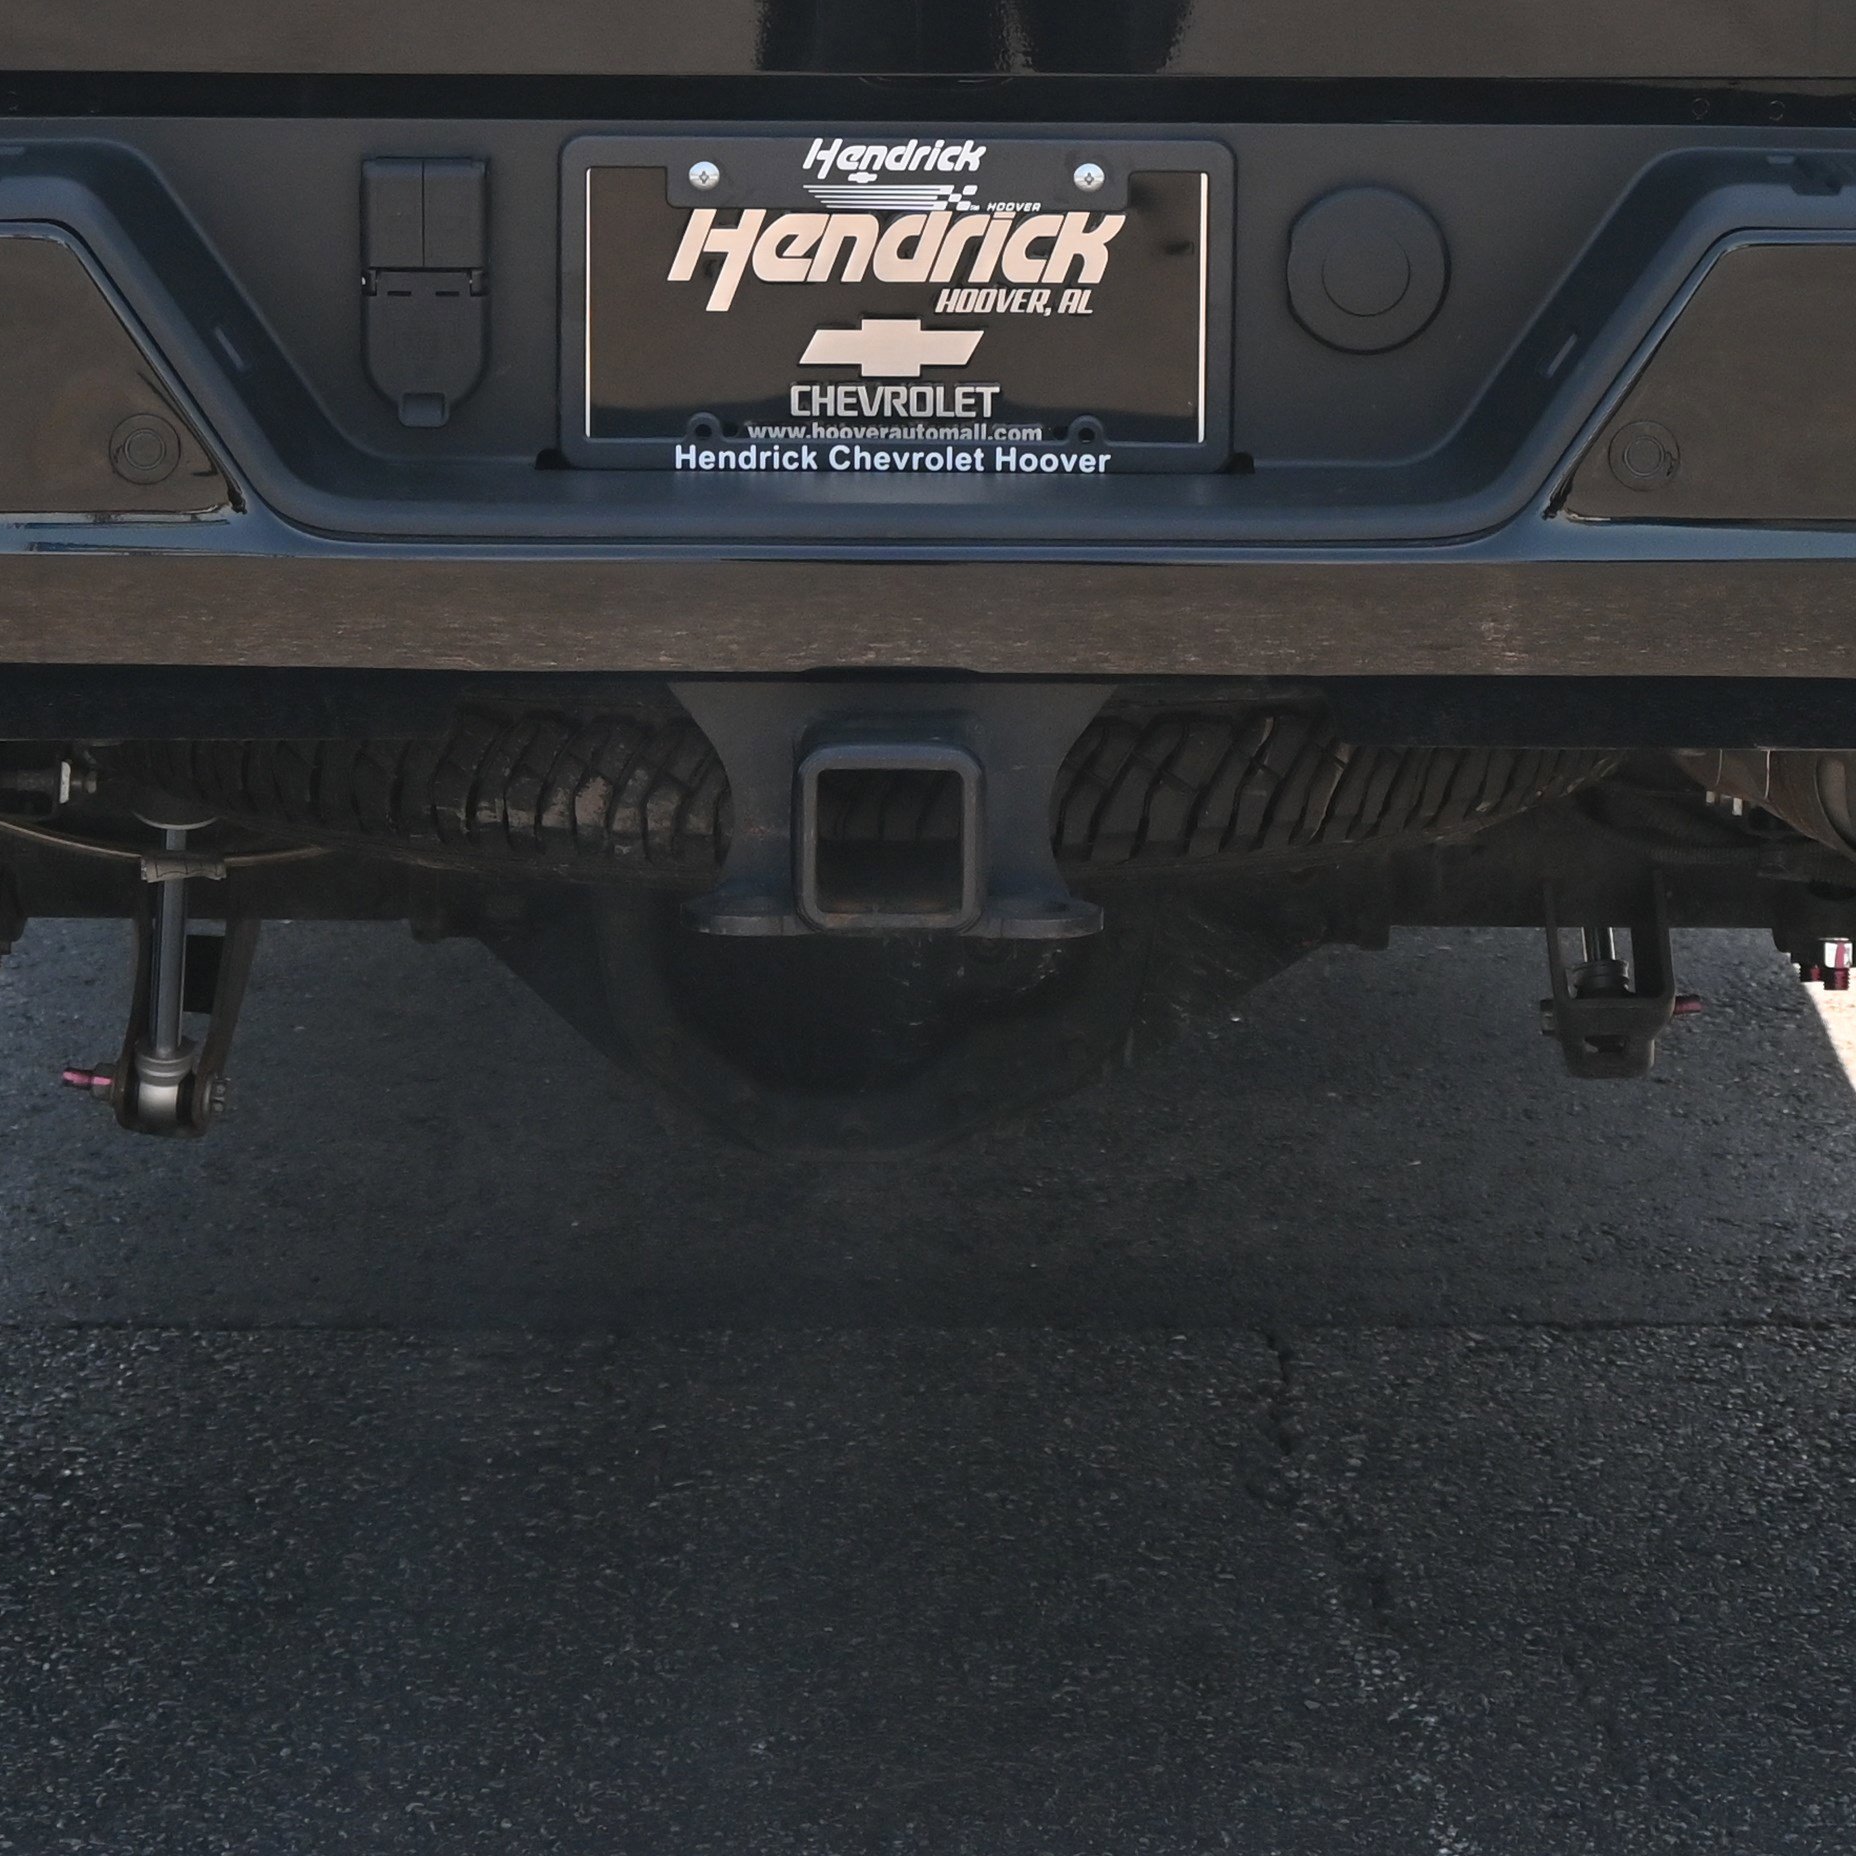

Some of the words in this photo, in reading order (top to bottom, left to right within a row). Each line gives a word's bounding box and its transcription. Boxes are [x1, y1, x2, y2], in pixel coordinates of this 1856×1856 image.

[802, 137, 987, 179] Hendrick
[986, 201, 1042, 212] HOOVER
[667, 208, 1126, 312] Hendrick
[934, 288, 1052, 317] HOOVER,
[1057, 288, 1094, 314] AL
[790, 385, 1001, 418] CHEVROLET
[747, 421, 1043, 441] www.hooverautomall.com
[675, 444, 818, 471] Hendrick
[828, 444, 985, 472] Chevrolet
[995, 446, 1112, 473] Hoover
